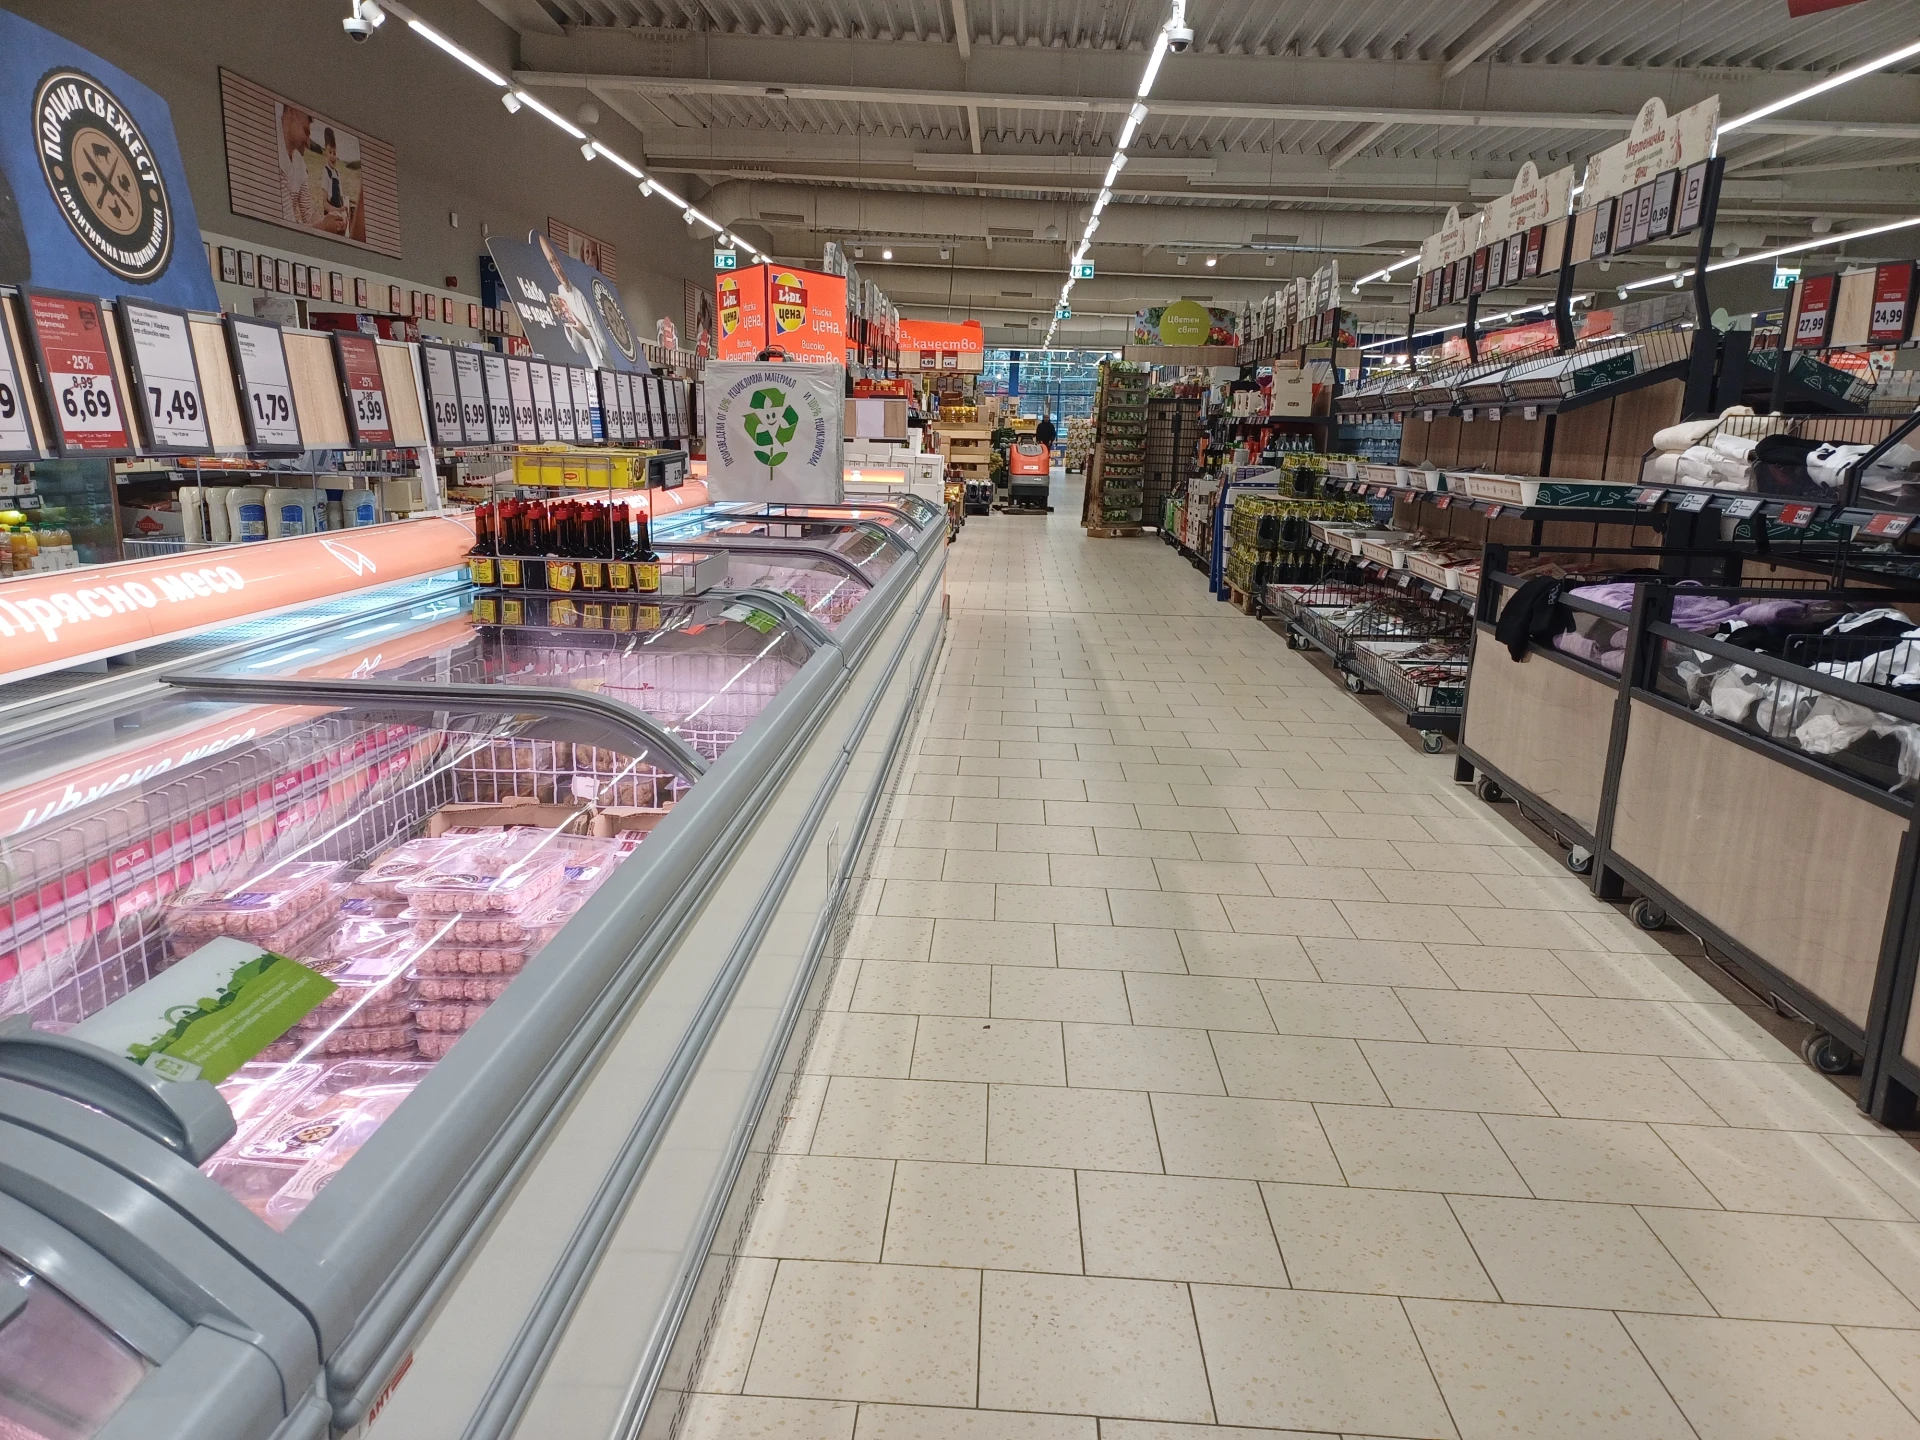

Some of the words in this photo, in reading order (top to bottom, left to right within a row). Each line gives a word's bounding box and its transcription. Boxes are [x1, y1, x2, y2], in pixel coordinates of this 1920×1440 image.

[43, 84, 83, 161] ПОРЦИЯ
[84, 88, 158, 185] СВЕЖЕСТ
[1652, 206, 1668, 223] 0,99
[60, 186, 119, 261] ГАРАНТИРАНА
[118, 242, 157, 269] ХЛАДИЛНА
[150, 207, 163, 249] ВЕРИГА
[724, 310, 737, 326] цена
[779, 308, 802, 322] цена
[812, 306, 832, 317] Ниска
[1168, 316, 1199, 324] Цветен
[1874, 309, 1903, 325] 24,99
[812, 319, 843, 337] цена,
[1178, 326, 1199, 334] свят
[1799, 317, 1824, 333] 27,99
[802, 340, 825, 350] Високо
[913, 338, 980, 350] качество.
[727, 372, 764, 400] РЕЦИКЛИРАН
[764, 372, 797, 389] МАТЕРИАЛ
[802, 391, 811, 401] И
[63, 388, 111, 422] 6,69
[149, 386, 198, 425] 7,49
[253, 393, 290, 426] 1,79
[358, 401, 382, 424] 5,99
[436, 402, 457, 427] 2,69
[464, 403, 485, 427] 6,99
[492, 405, 510, 428] 7,99
[516, 406, 532, 428] 4,99
[538, 407, 552, 428] 6,49
[558, 408, 572, 428] 4,39
[576, 409, 589, 428] 7,49
[152, 566, 244, 603] месо
